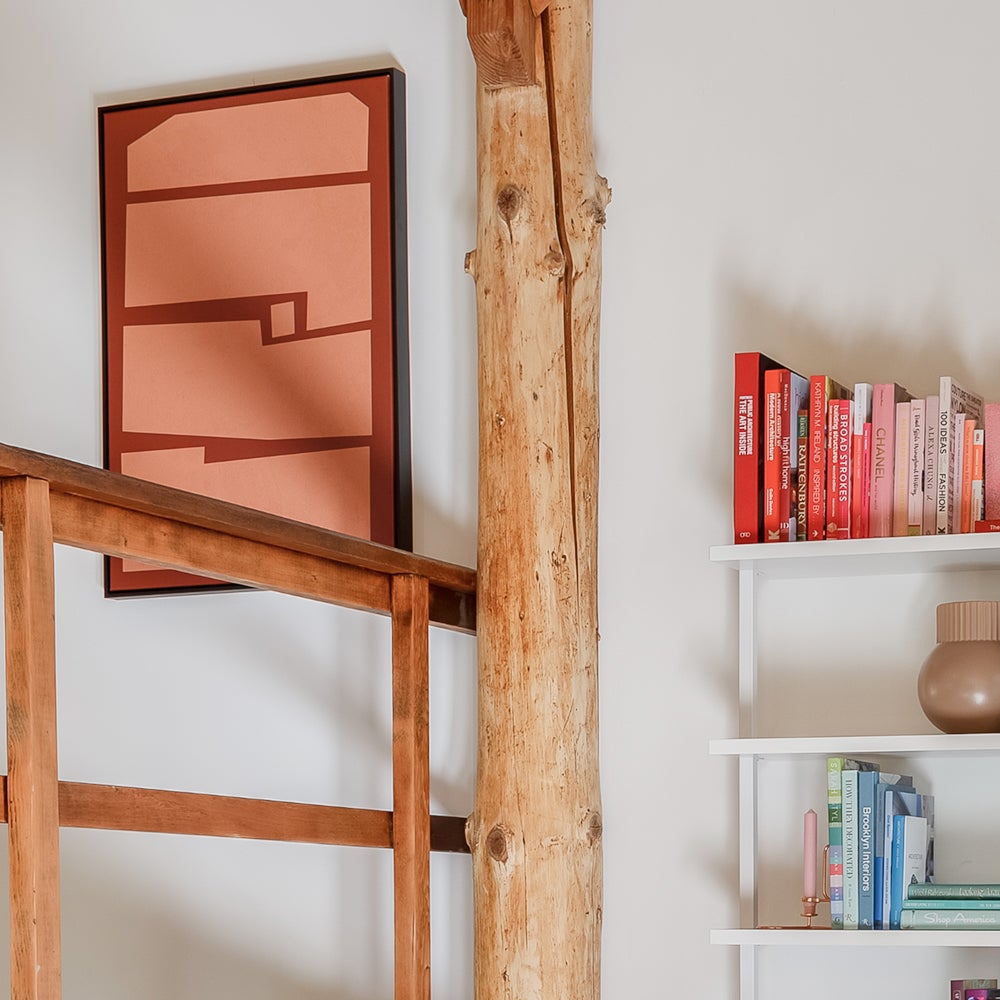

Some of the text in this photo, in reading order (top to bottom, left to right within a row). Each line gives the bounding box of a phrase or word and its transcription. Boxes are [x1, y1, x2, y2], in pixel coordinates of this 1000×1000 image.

[739, 400, 747, 455] THE ART INSIDE
[874, 427, 886, 482] CHANEL
[838, 414, 848, 502] BROAD STROKES
[798, 444, 807, 528] RATTENBURY
[812, 470, 820, 503] INSPIRED
[938, 473, 946, 512] FASHION
[861, 807, 871, 892] Brooklyn Interiors
